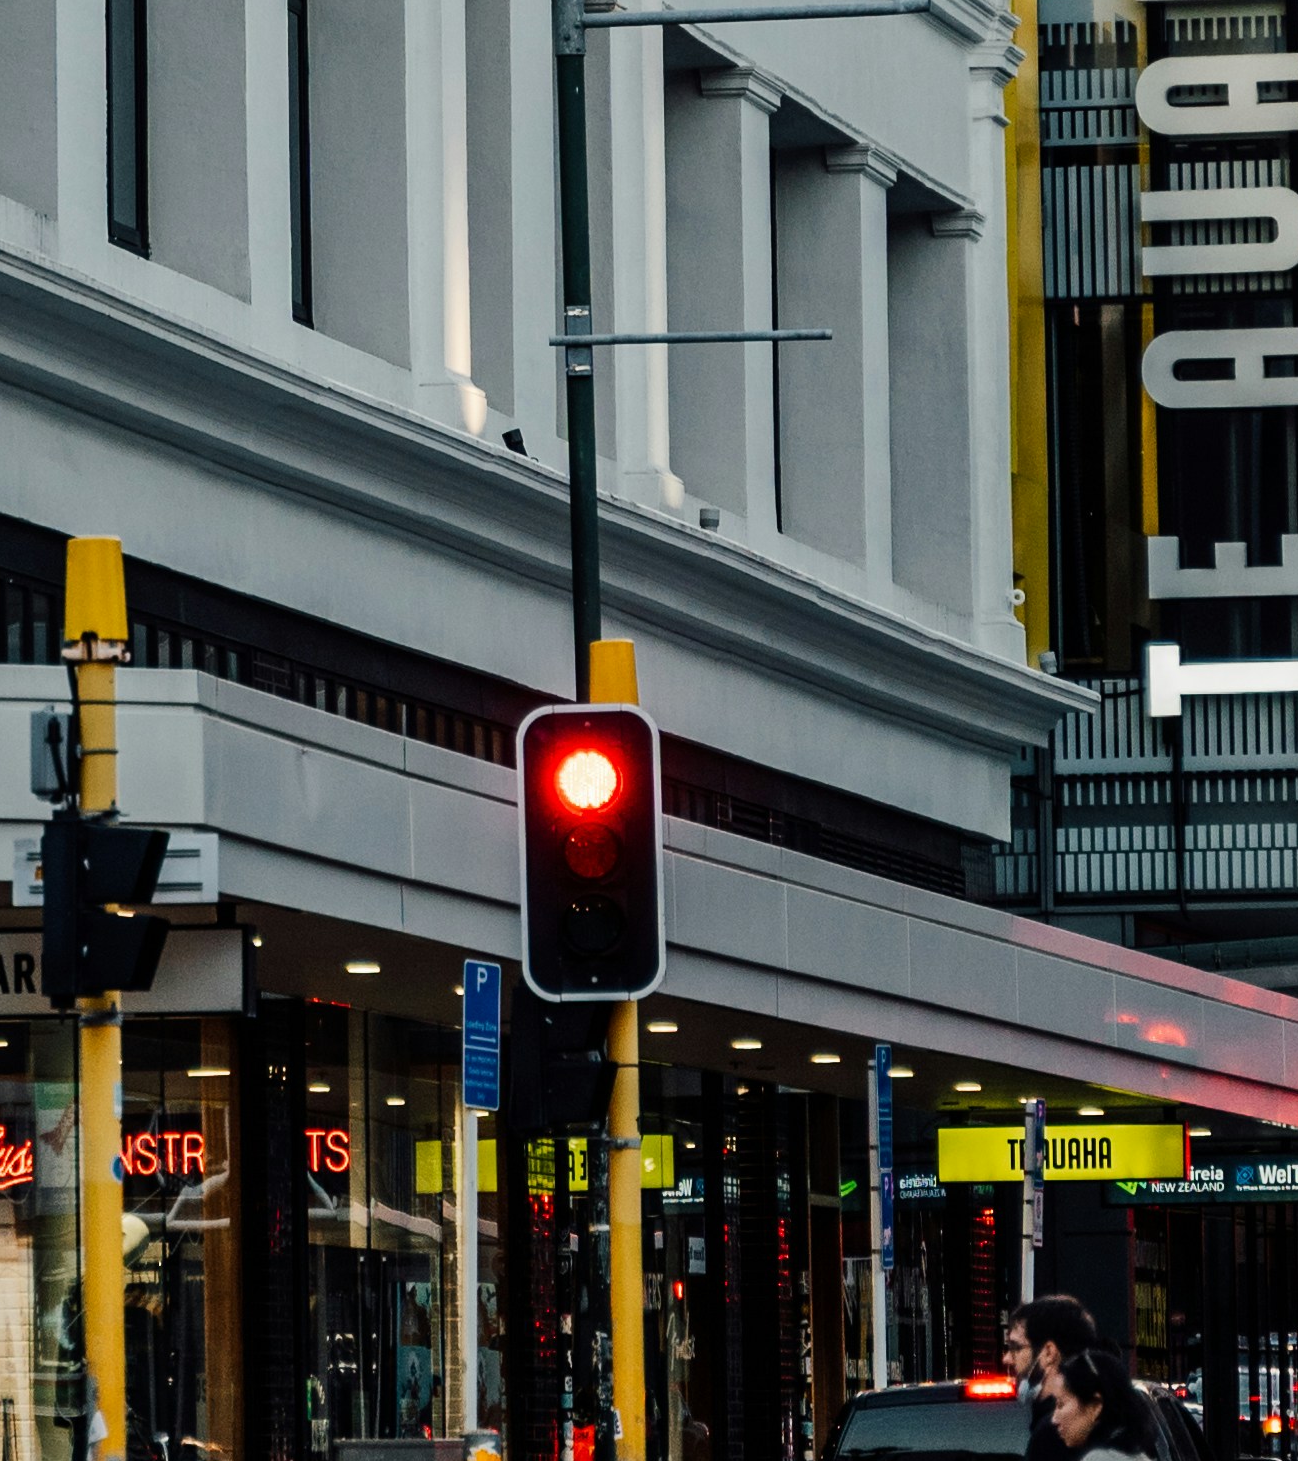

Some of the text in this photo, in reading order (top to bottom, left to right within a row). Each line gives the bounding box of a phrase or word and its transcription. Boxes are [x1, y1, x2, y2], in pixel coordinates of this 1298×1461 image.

[477, 967, 488, 993] P
[1189, 1165, 1224, 1181] ireia
[1151, 1182, 1177, 1193] NEW
[1178, 1180, 1225, 1193] ZEALAND
